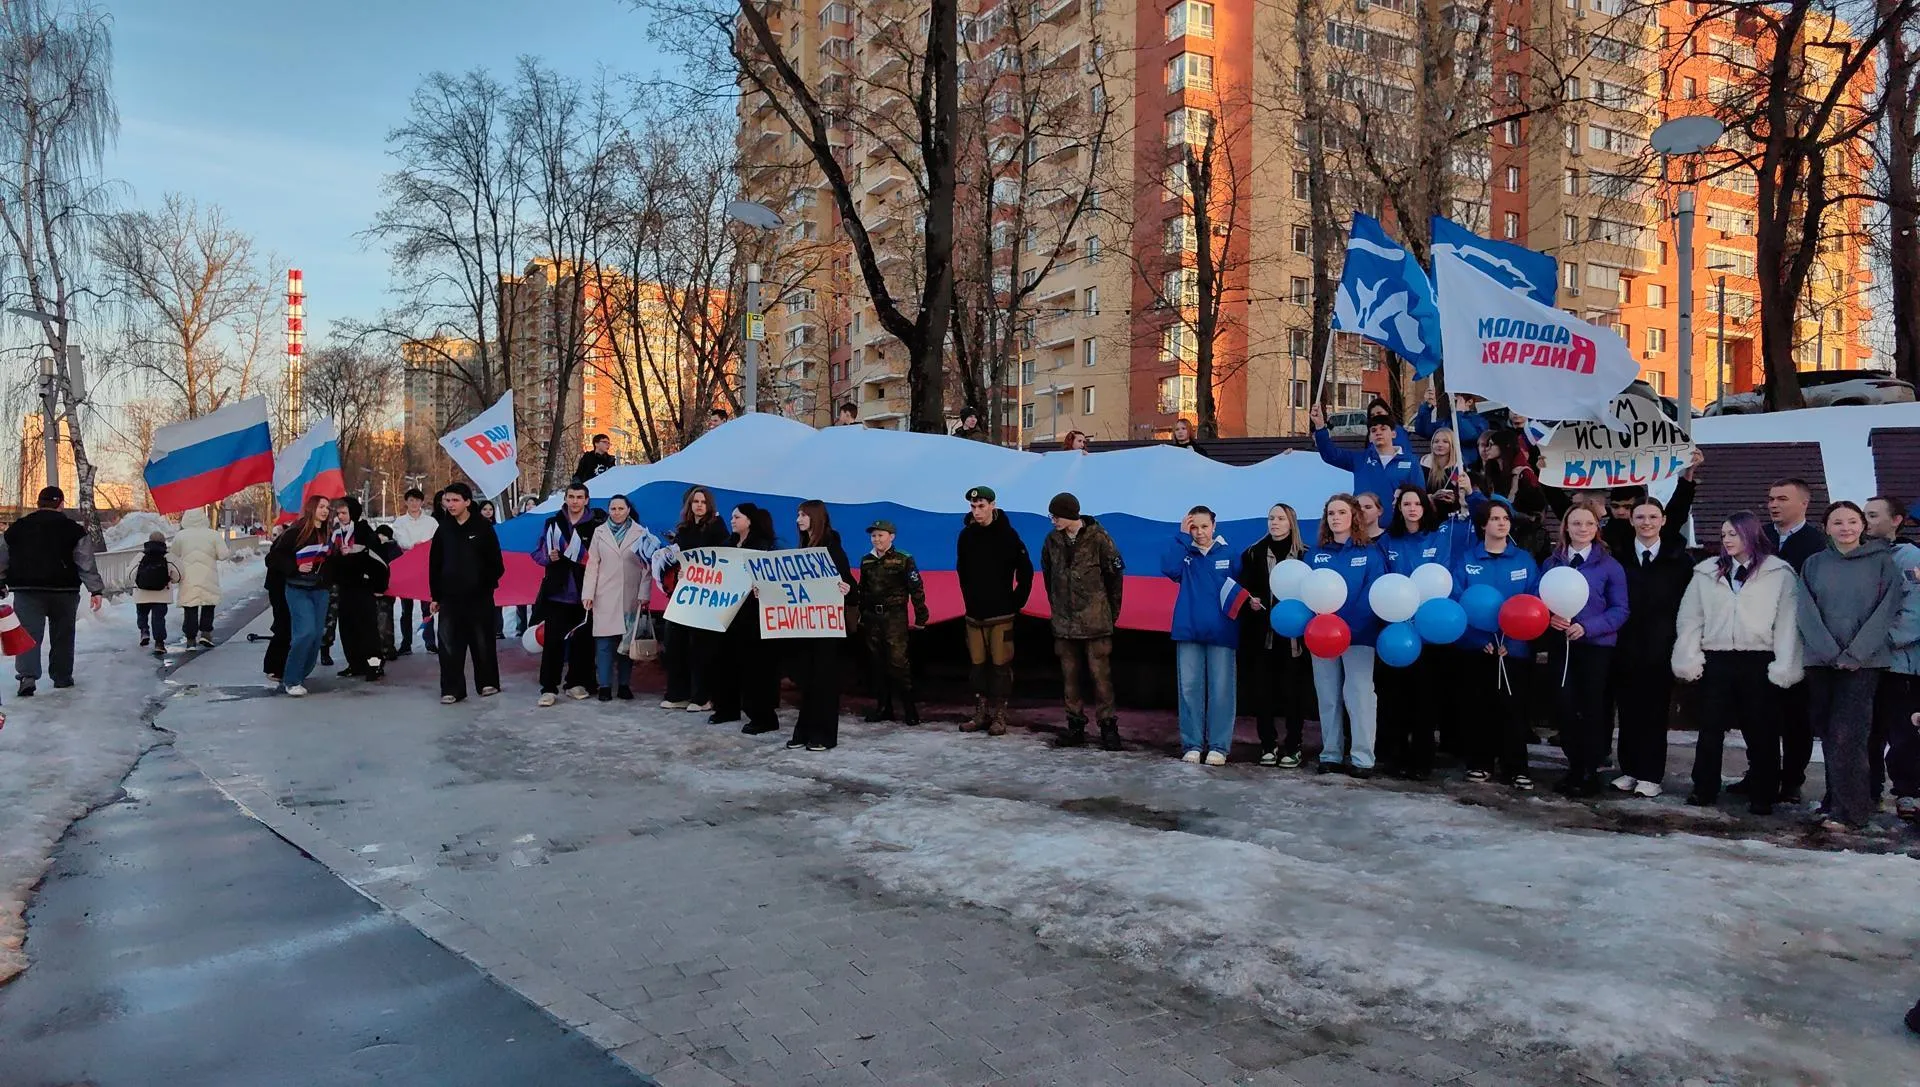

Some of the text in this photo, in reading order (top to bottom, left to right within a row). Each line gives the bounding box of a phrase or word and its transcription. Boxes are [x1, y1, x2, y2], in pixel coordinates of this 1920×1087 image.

[1563, 444, 1690, 487] ВМЕСТЕ
[686, 565, 723, 585] ОДНА
[782, 583, 811, 604] ЗА
